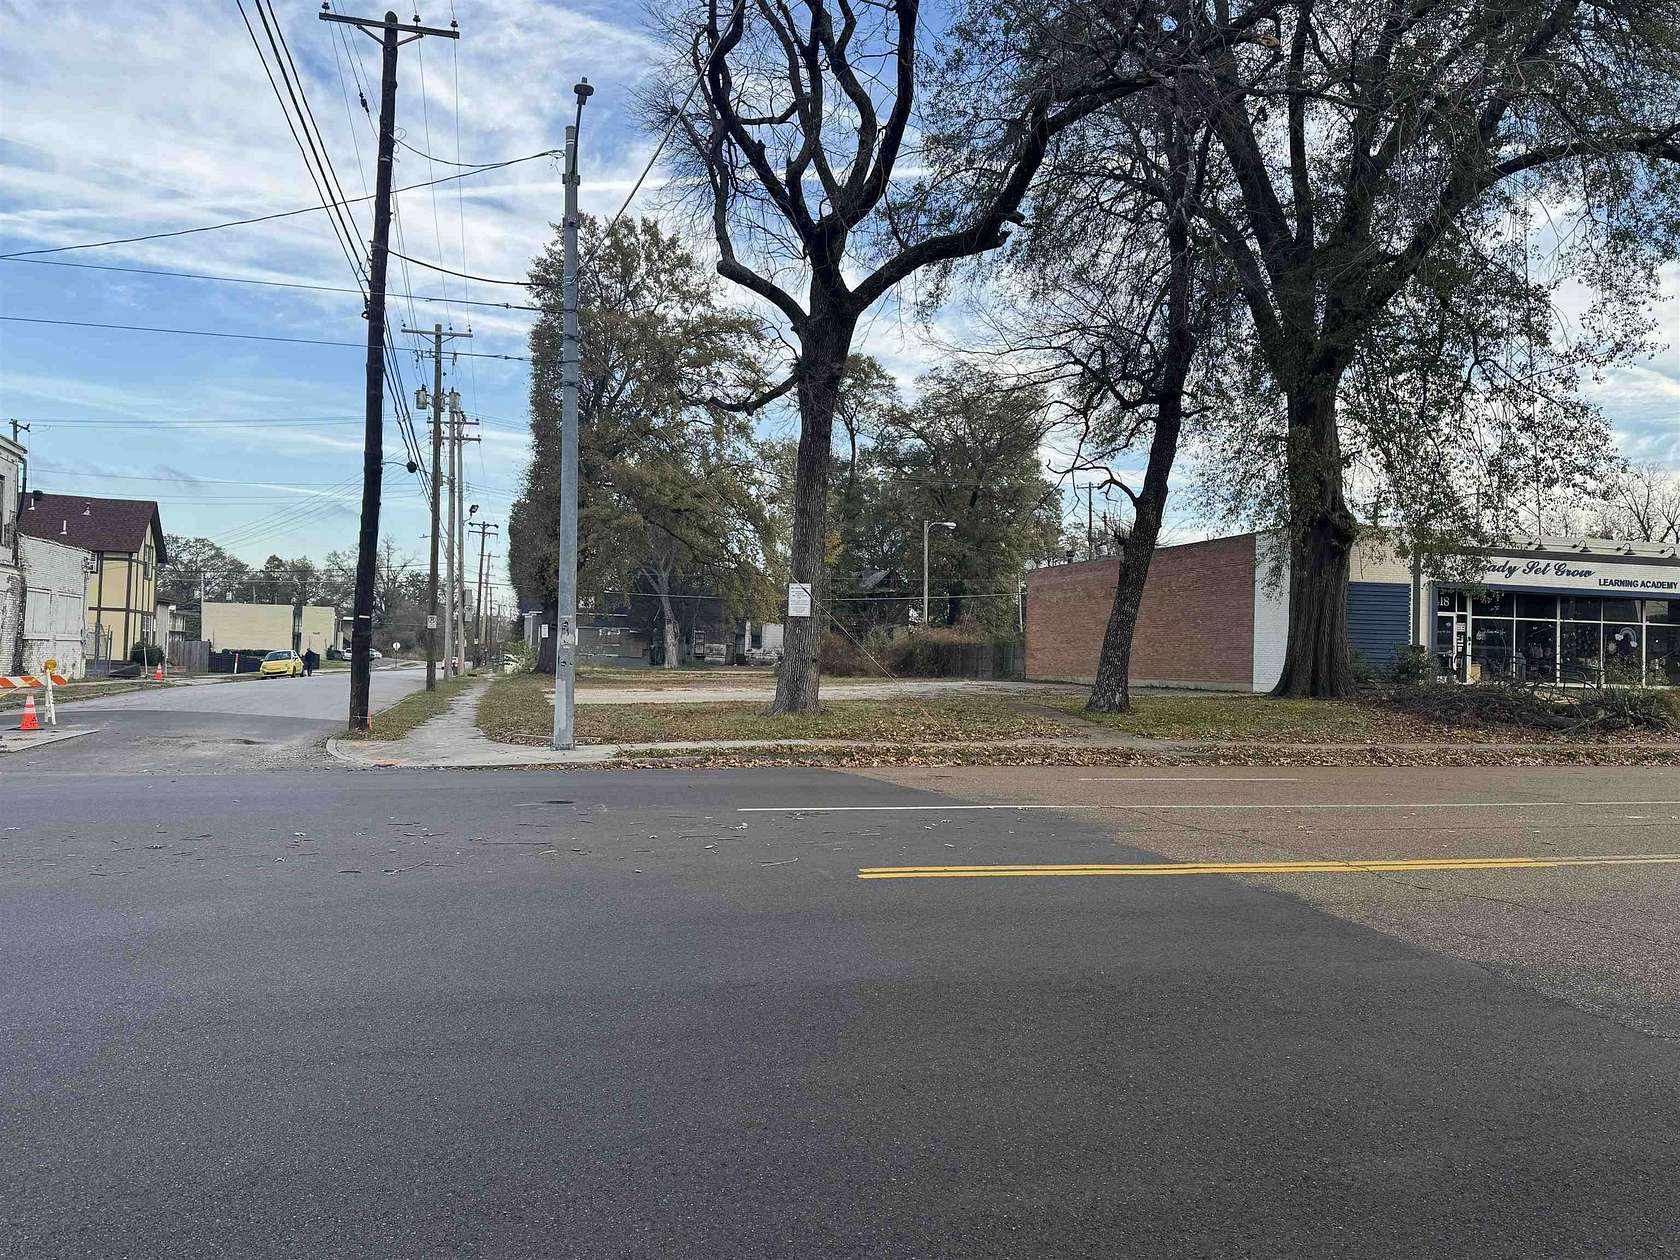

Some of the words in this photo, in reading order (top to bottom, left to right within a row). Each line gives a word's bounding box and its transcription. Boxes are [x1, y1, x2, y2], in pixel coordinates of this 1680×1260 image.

[1482, 560, 1521, 579] ady
[1522, 560, 1552, 576] Set
[1553, 562, 1596, 578] Grow
[1598, 578, 1639, 588] LEARNING
[1640, 580, 1678, 590] ACADEMY
